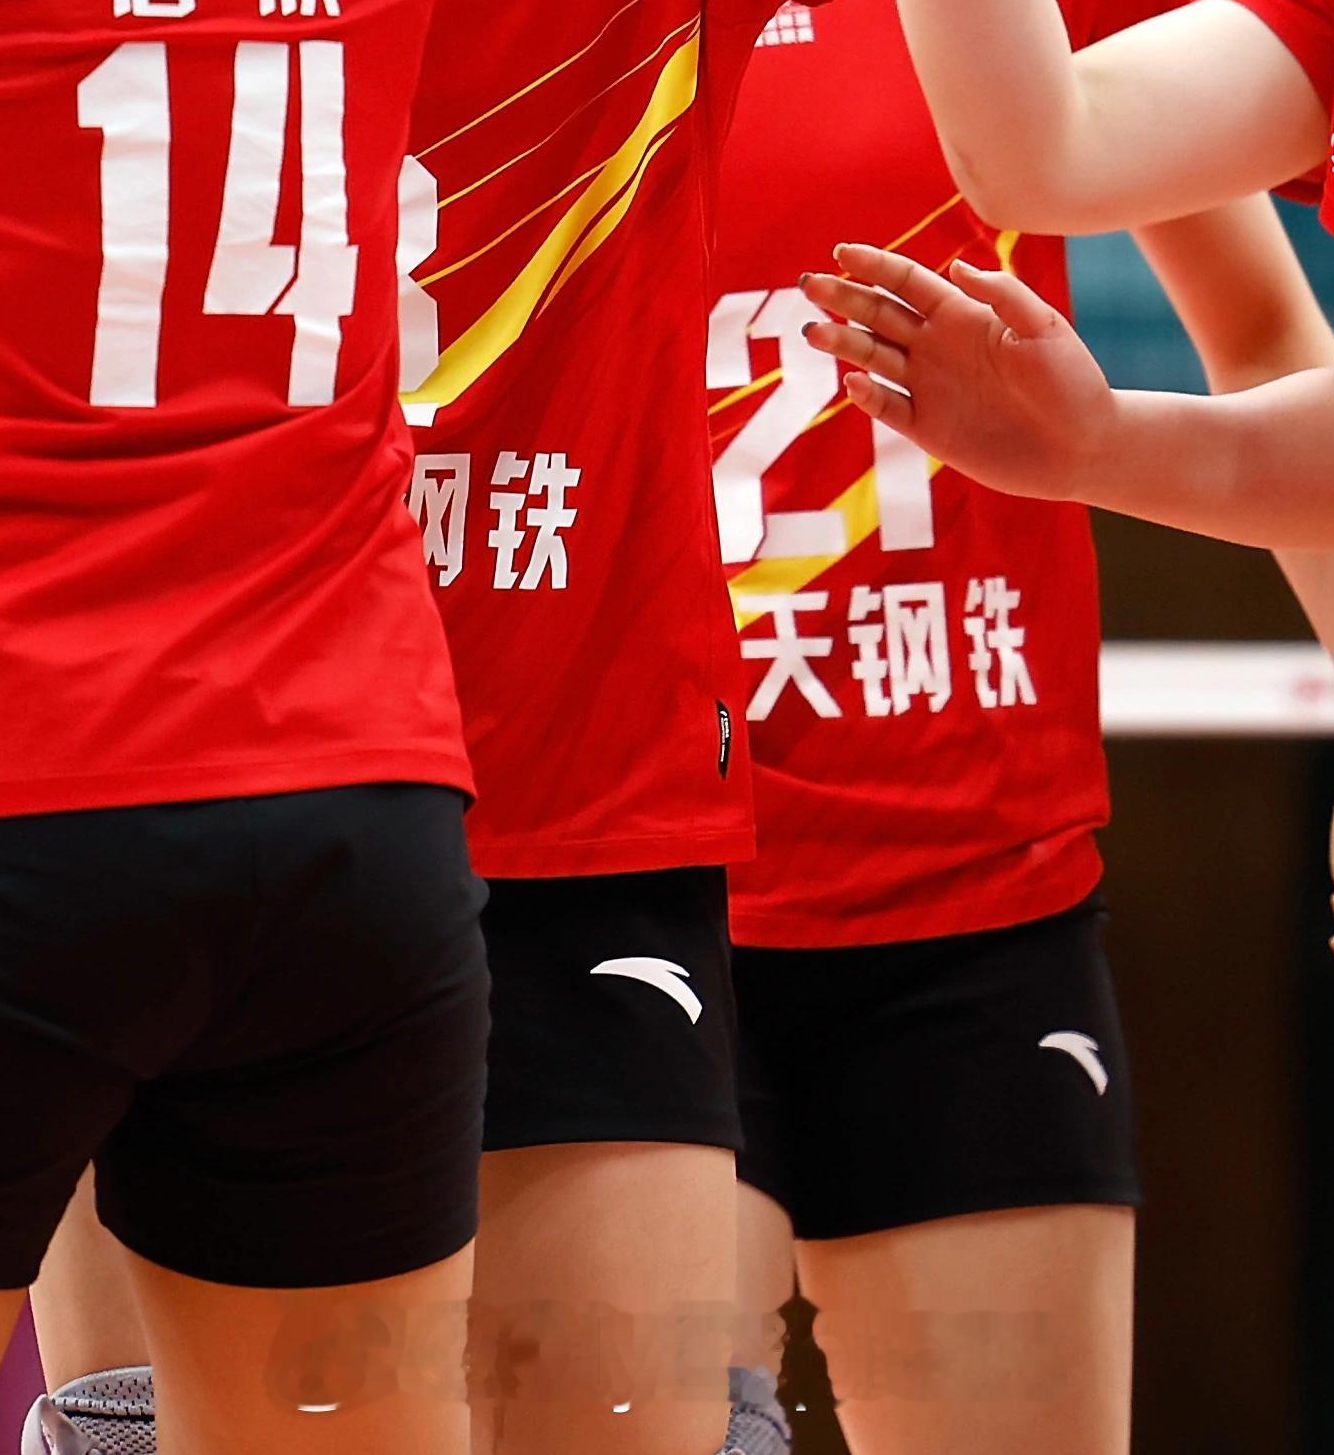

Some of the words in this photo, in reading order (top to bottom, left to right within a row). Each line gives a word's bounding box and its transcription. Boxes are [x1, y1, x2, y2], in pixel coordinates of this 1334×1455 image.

[77, 40, 359, 408] 14
[740, 577, 1037, 721] 天钢铁
